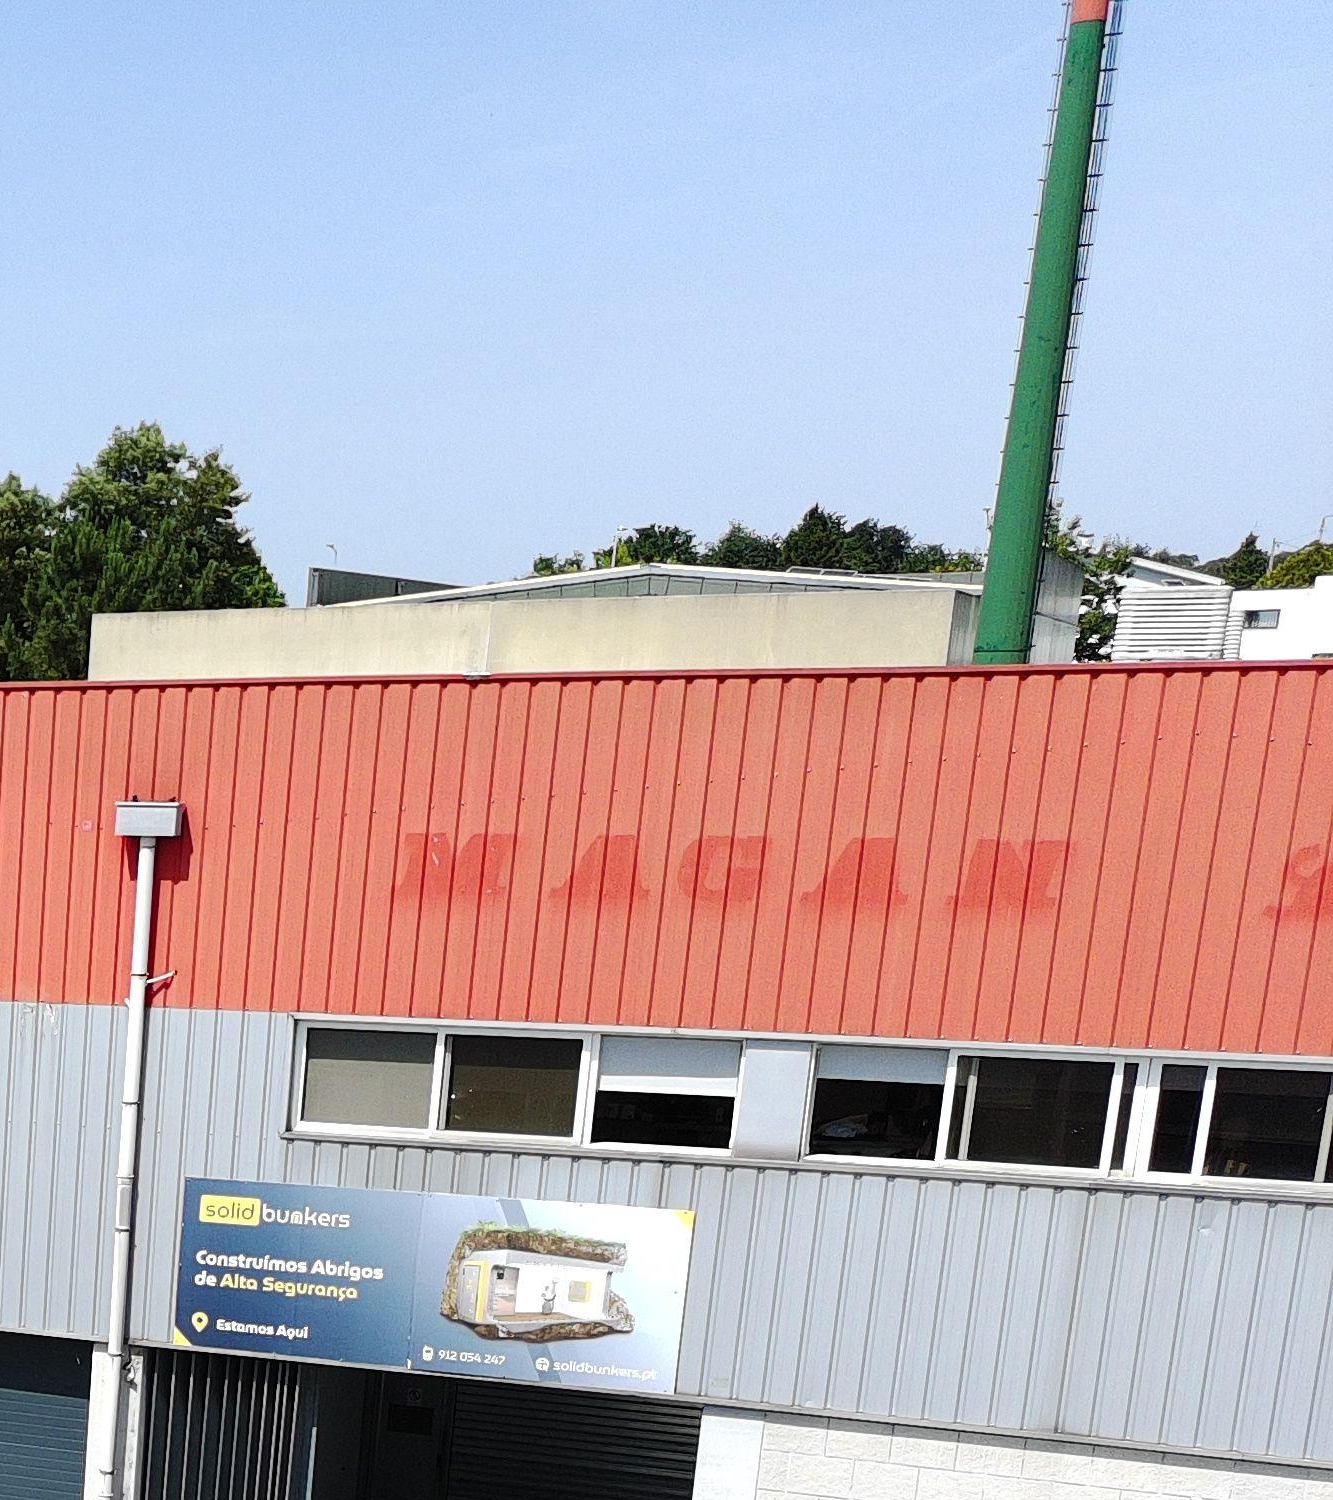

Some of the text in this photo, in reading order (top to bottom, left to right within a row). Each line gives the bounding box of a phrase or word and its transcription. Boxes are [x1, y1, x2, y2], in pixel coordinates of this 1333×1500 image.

[206, 1202, 351, 1228] solid bunkers
[310, 1259, 384, 1282] Abrigos
[194, 1270, 358, 1302] de Alta Segurança
[216, 1318, 309, 1340] Estamos Aqui
[438, 1349, 457, 1361] 912
